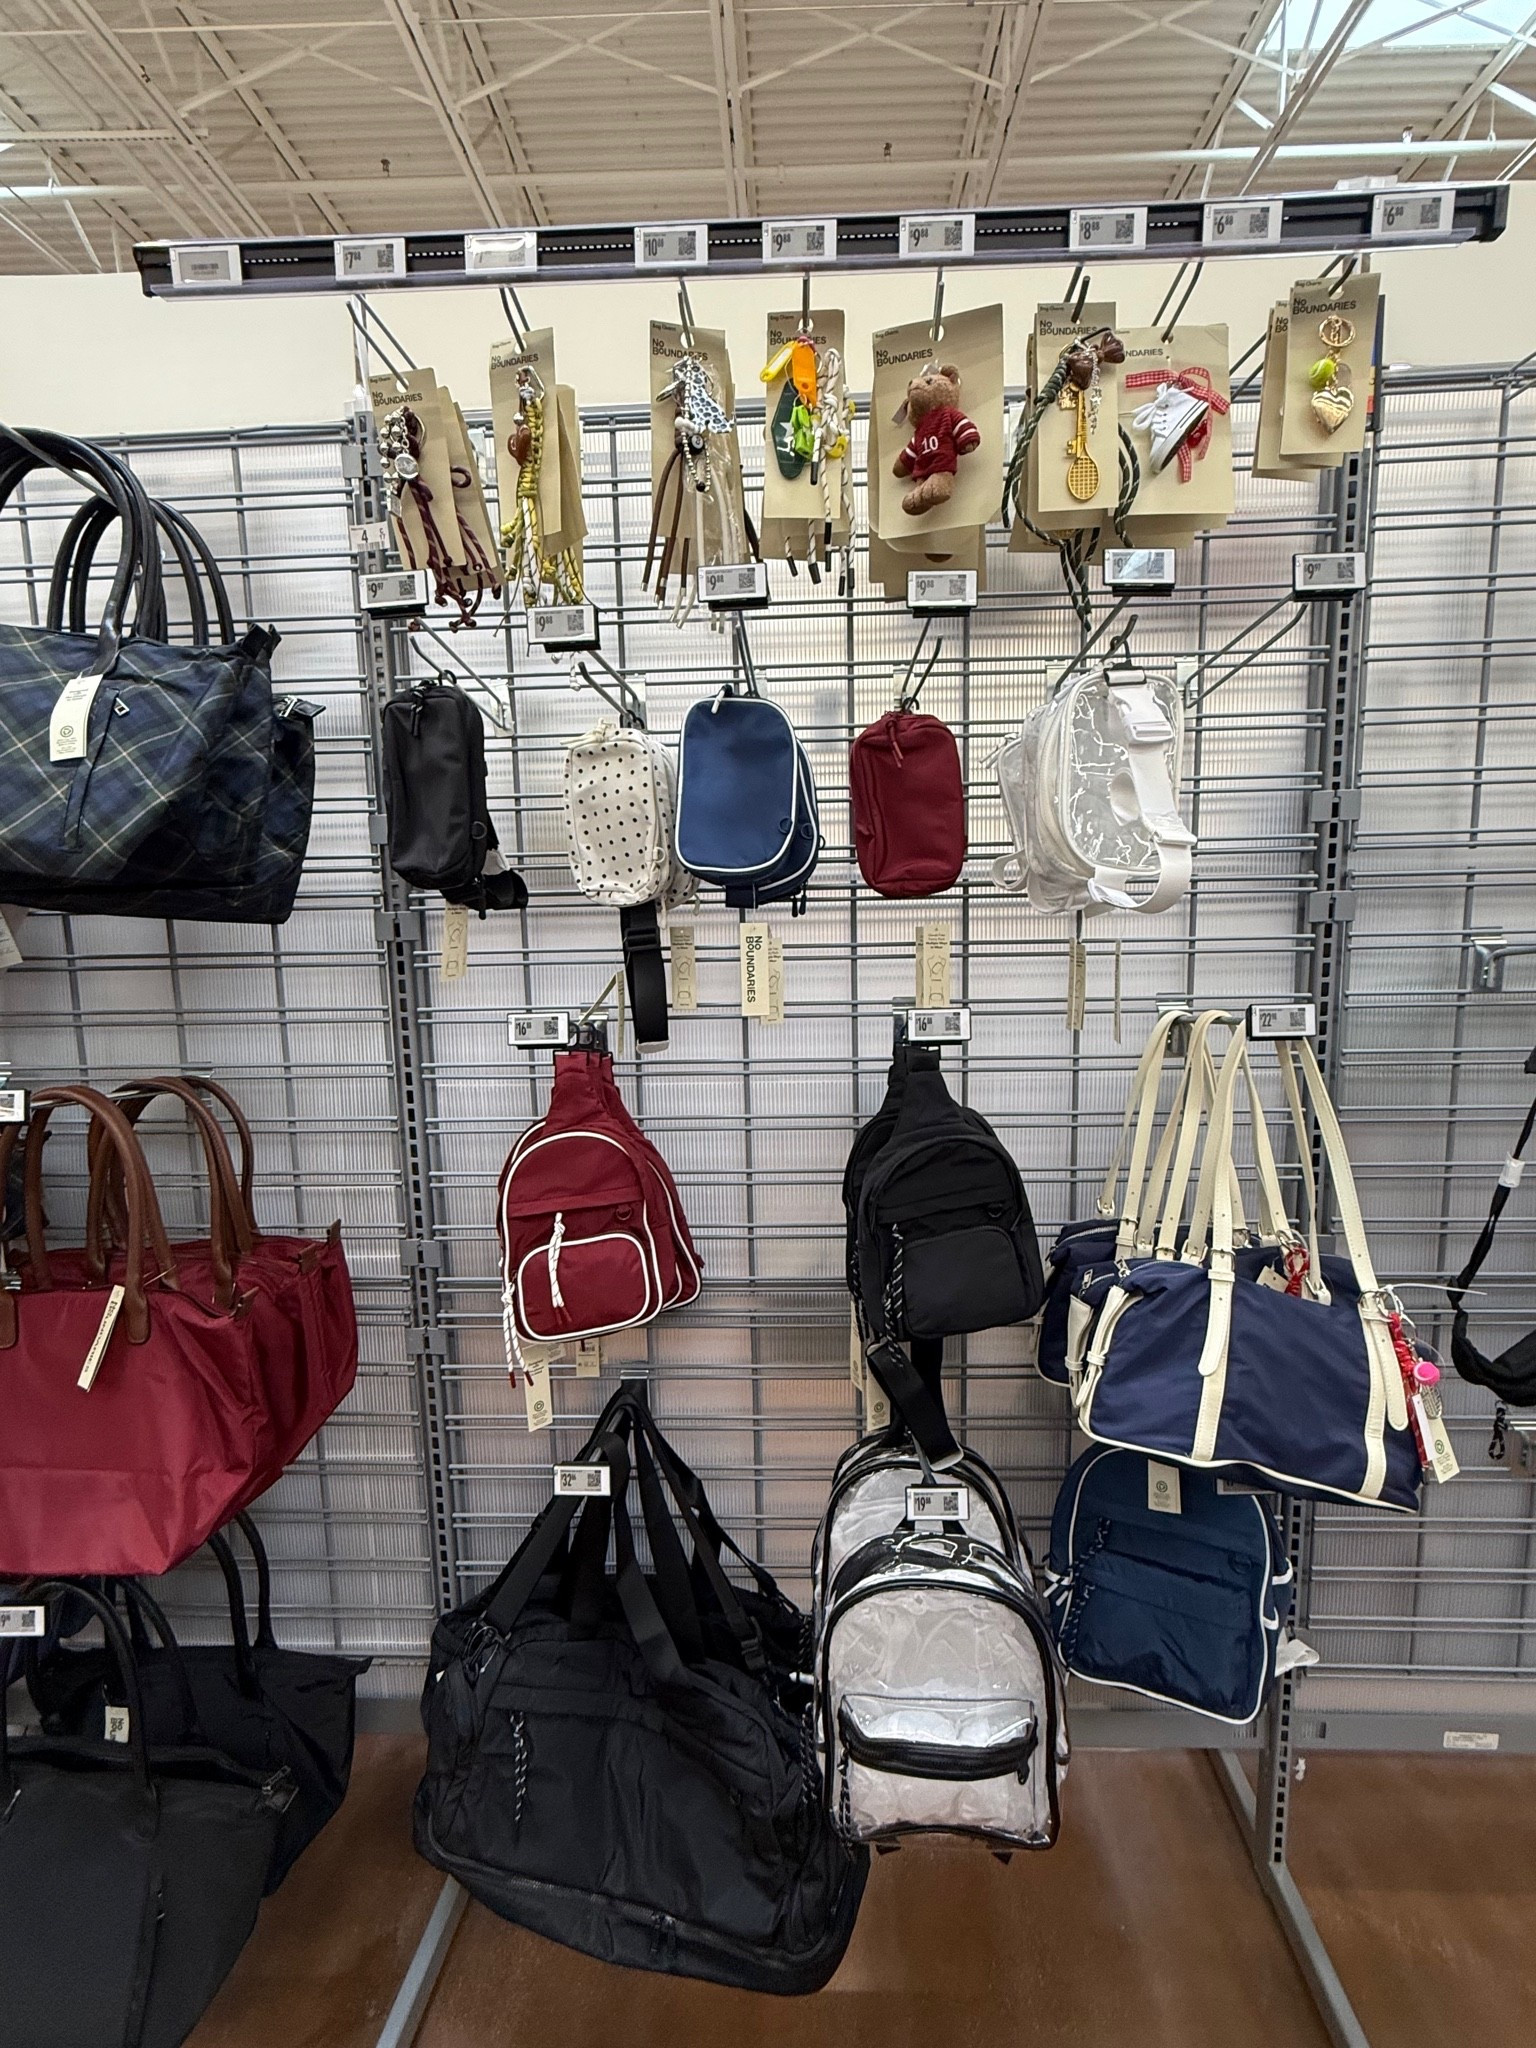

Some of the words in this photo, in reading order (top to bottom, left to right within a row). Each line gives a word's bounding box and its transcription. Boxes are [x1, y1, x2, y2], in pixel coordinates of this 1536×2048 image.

[1292, 300, 1356, 315] BOUNDARIES
[1040, 326, 1097, 336] BOUNDARIES
[491, 353, 539, 370] BOUNDARIES
[876, 348, 933, 367] BOUNDARIES
[373, 393, 423, 407] BOUNDARIES
[921, 436, 938, 454] 10
[361, 530, 368, 543] 4
[754, 936, 762, 950] NO
[745, 936, 756, 1003] BOUNDARIES
